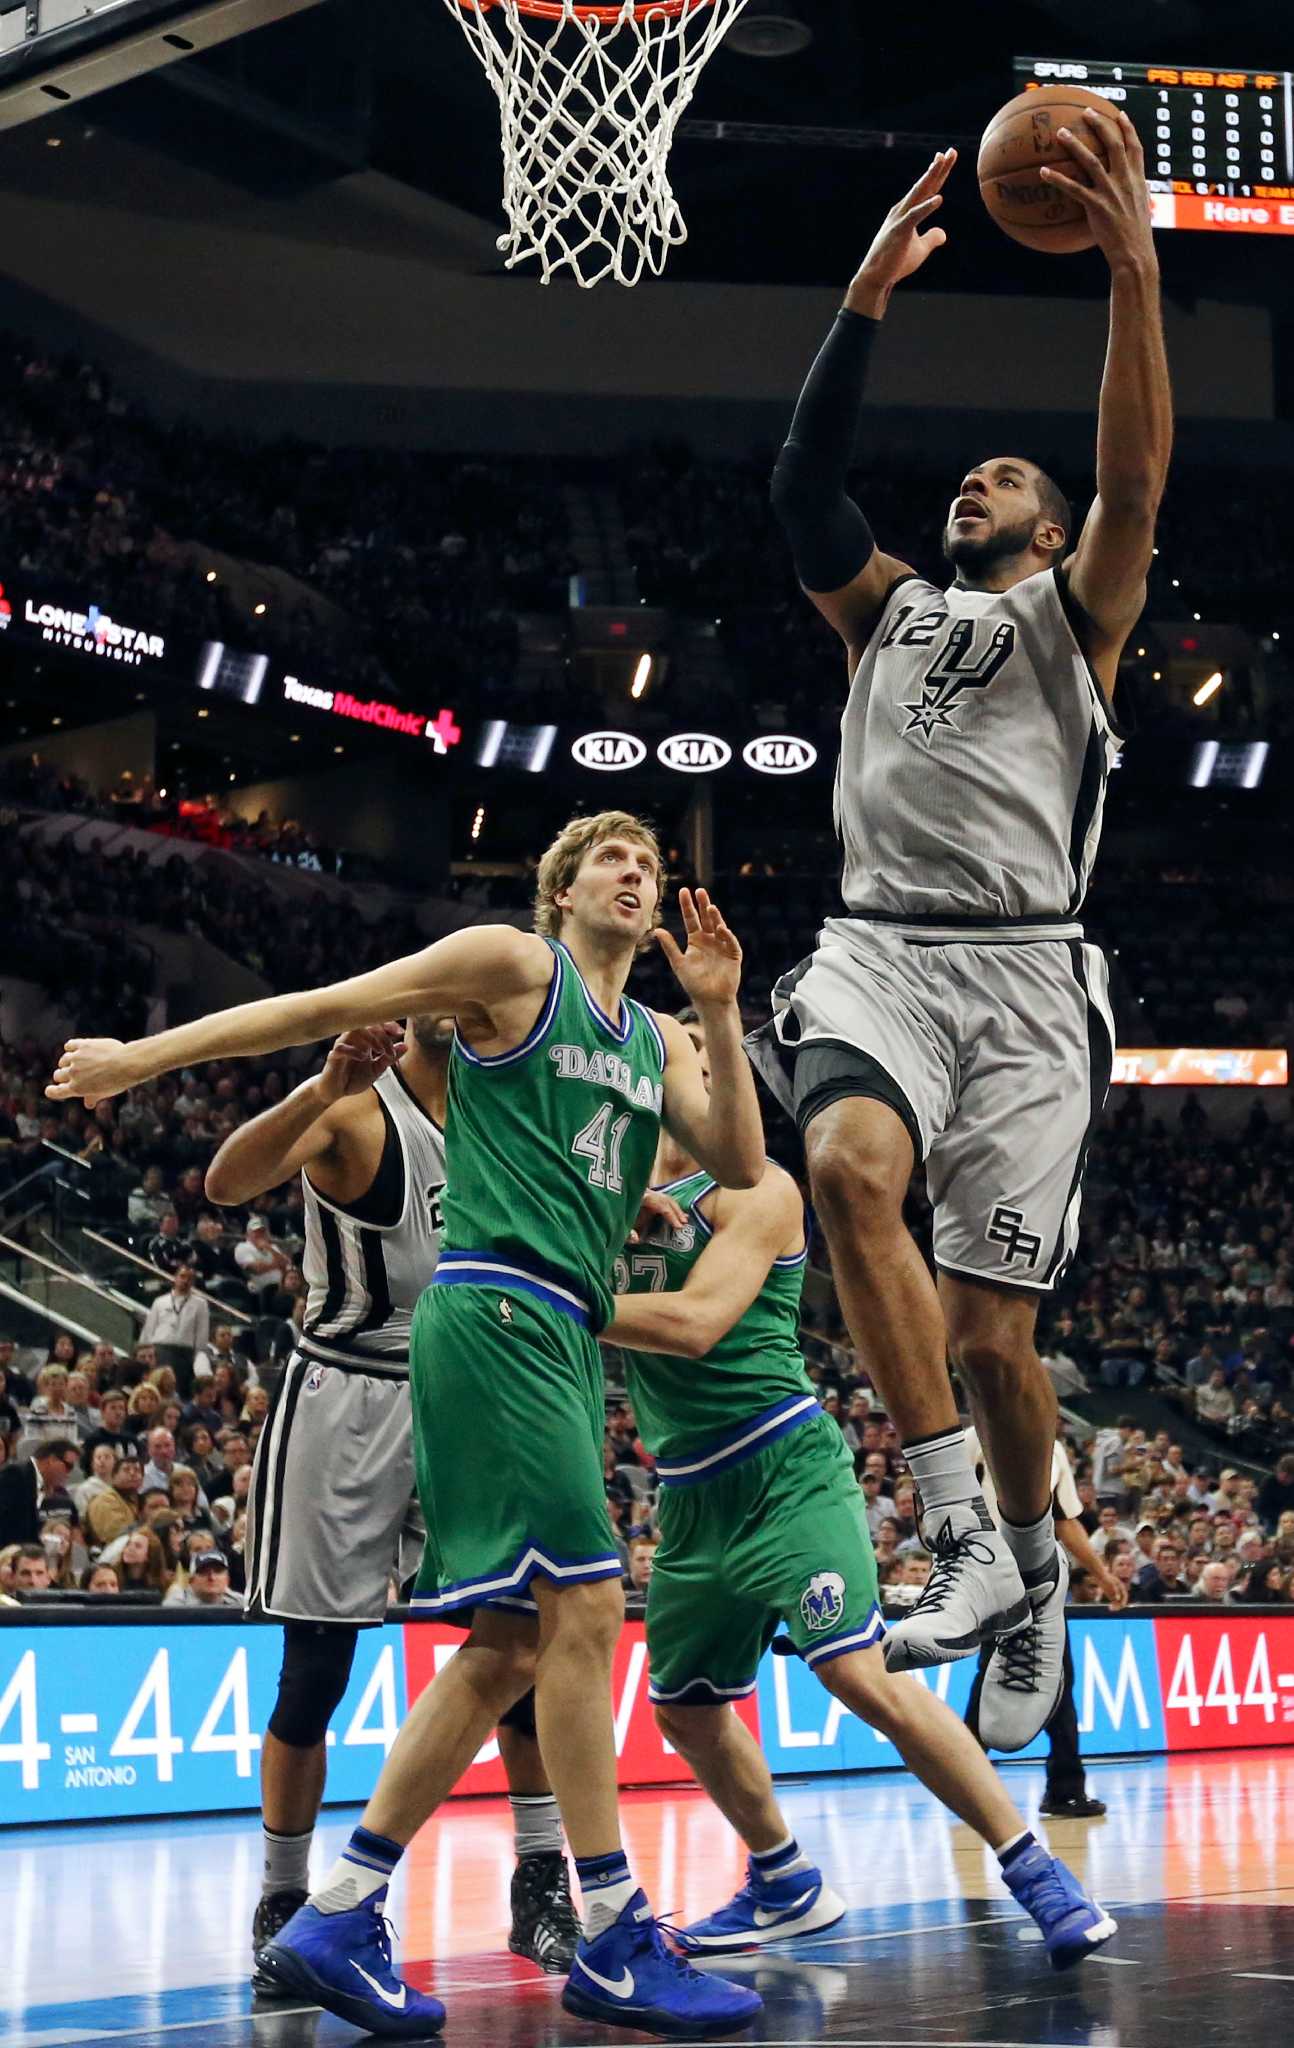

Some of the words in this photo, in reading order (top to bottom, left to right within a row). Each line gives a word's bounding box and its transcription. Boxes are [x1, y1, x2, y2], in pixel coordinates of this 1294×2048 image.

[1158, 90, 1168, 103] 1
[1193, 92, 1203, 105] 1
[1262, 114, 1272, 126] 1
[1203, 201, 1270, 224] Here
[25, 600, 88, 636] LONE
[106, 622, 164, 658] STAR
[881, 606, 948, 650] 12
[284, 675, 334, 711] Texas
[584, 739, 634, 764] KIA
[669, 741, 717, 765] KIA
[755, 743, 804, 767] KIA
[572, 1102, 632, 1194] 41
[64, 1745, 96, 1766] SAN
[64, 1764, 137, 1789] ANTONIO
